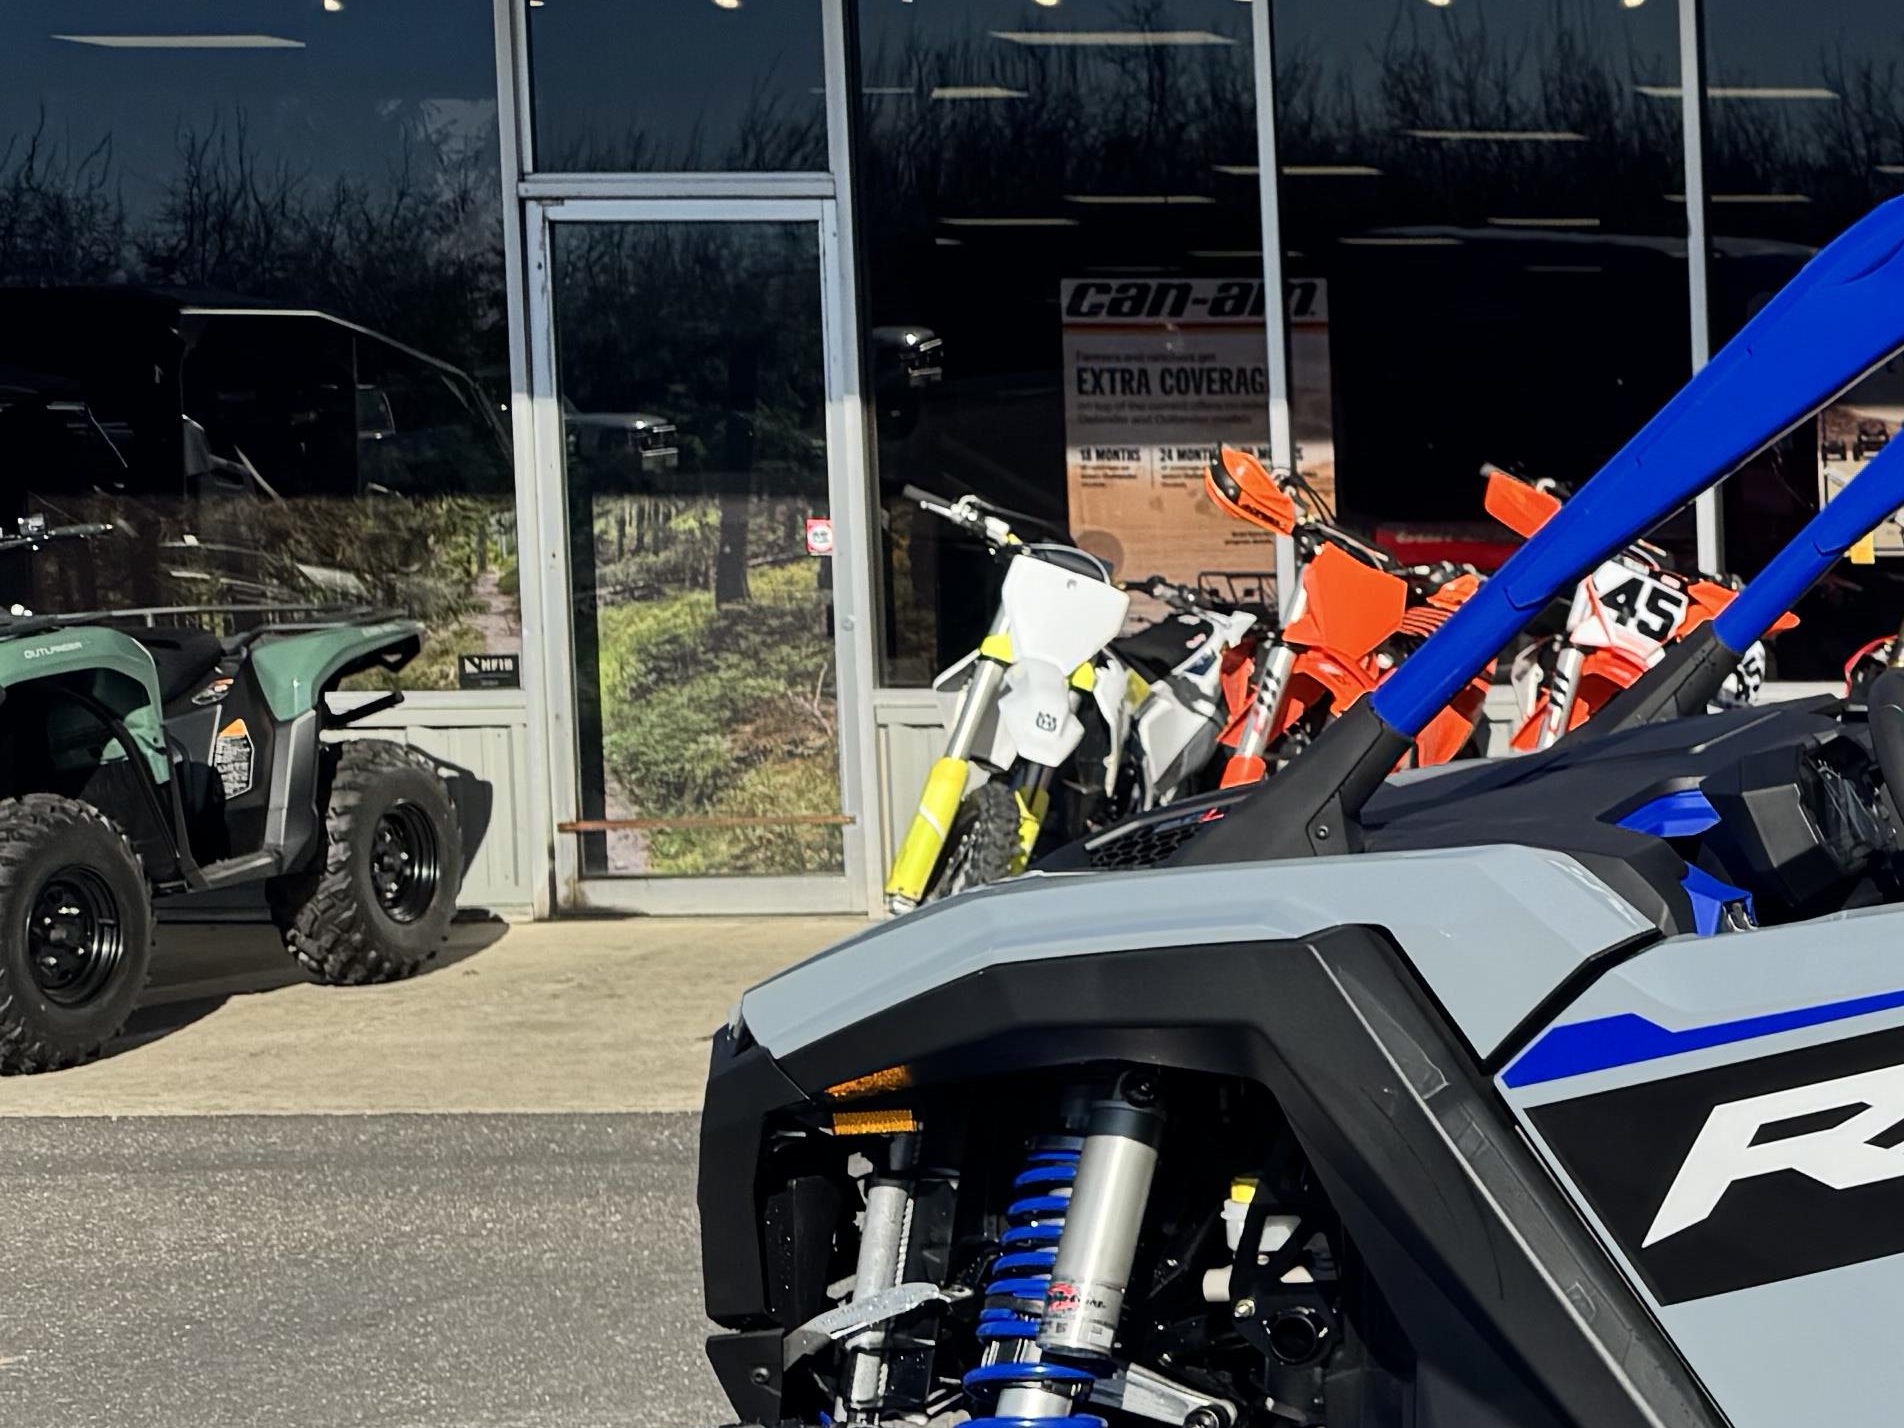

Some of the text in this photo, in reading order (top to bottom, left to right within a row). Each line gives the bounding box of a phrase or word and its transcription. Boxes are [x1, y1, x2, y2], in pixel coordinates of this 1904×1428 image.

[1066, 281, 1318, 318] can-am
[1076, 367, 1270, 396] EXTRA COVERAG
[1095, 447, 1142, 462] MONTHS
[1176, 447, 1213, 462] MONTH
[1598, 576, 1684, 644] 45
